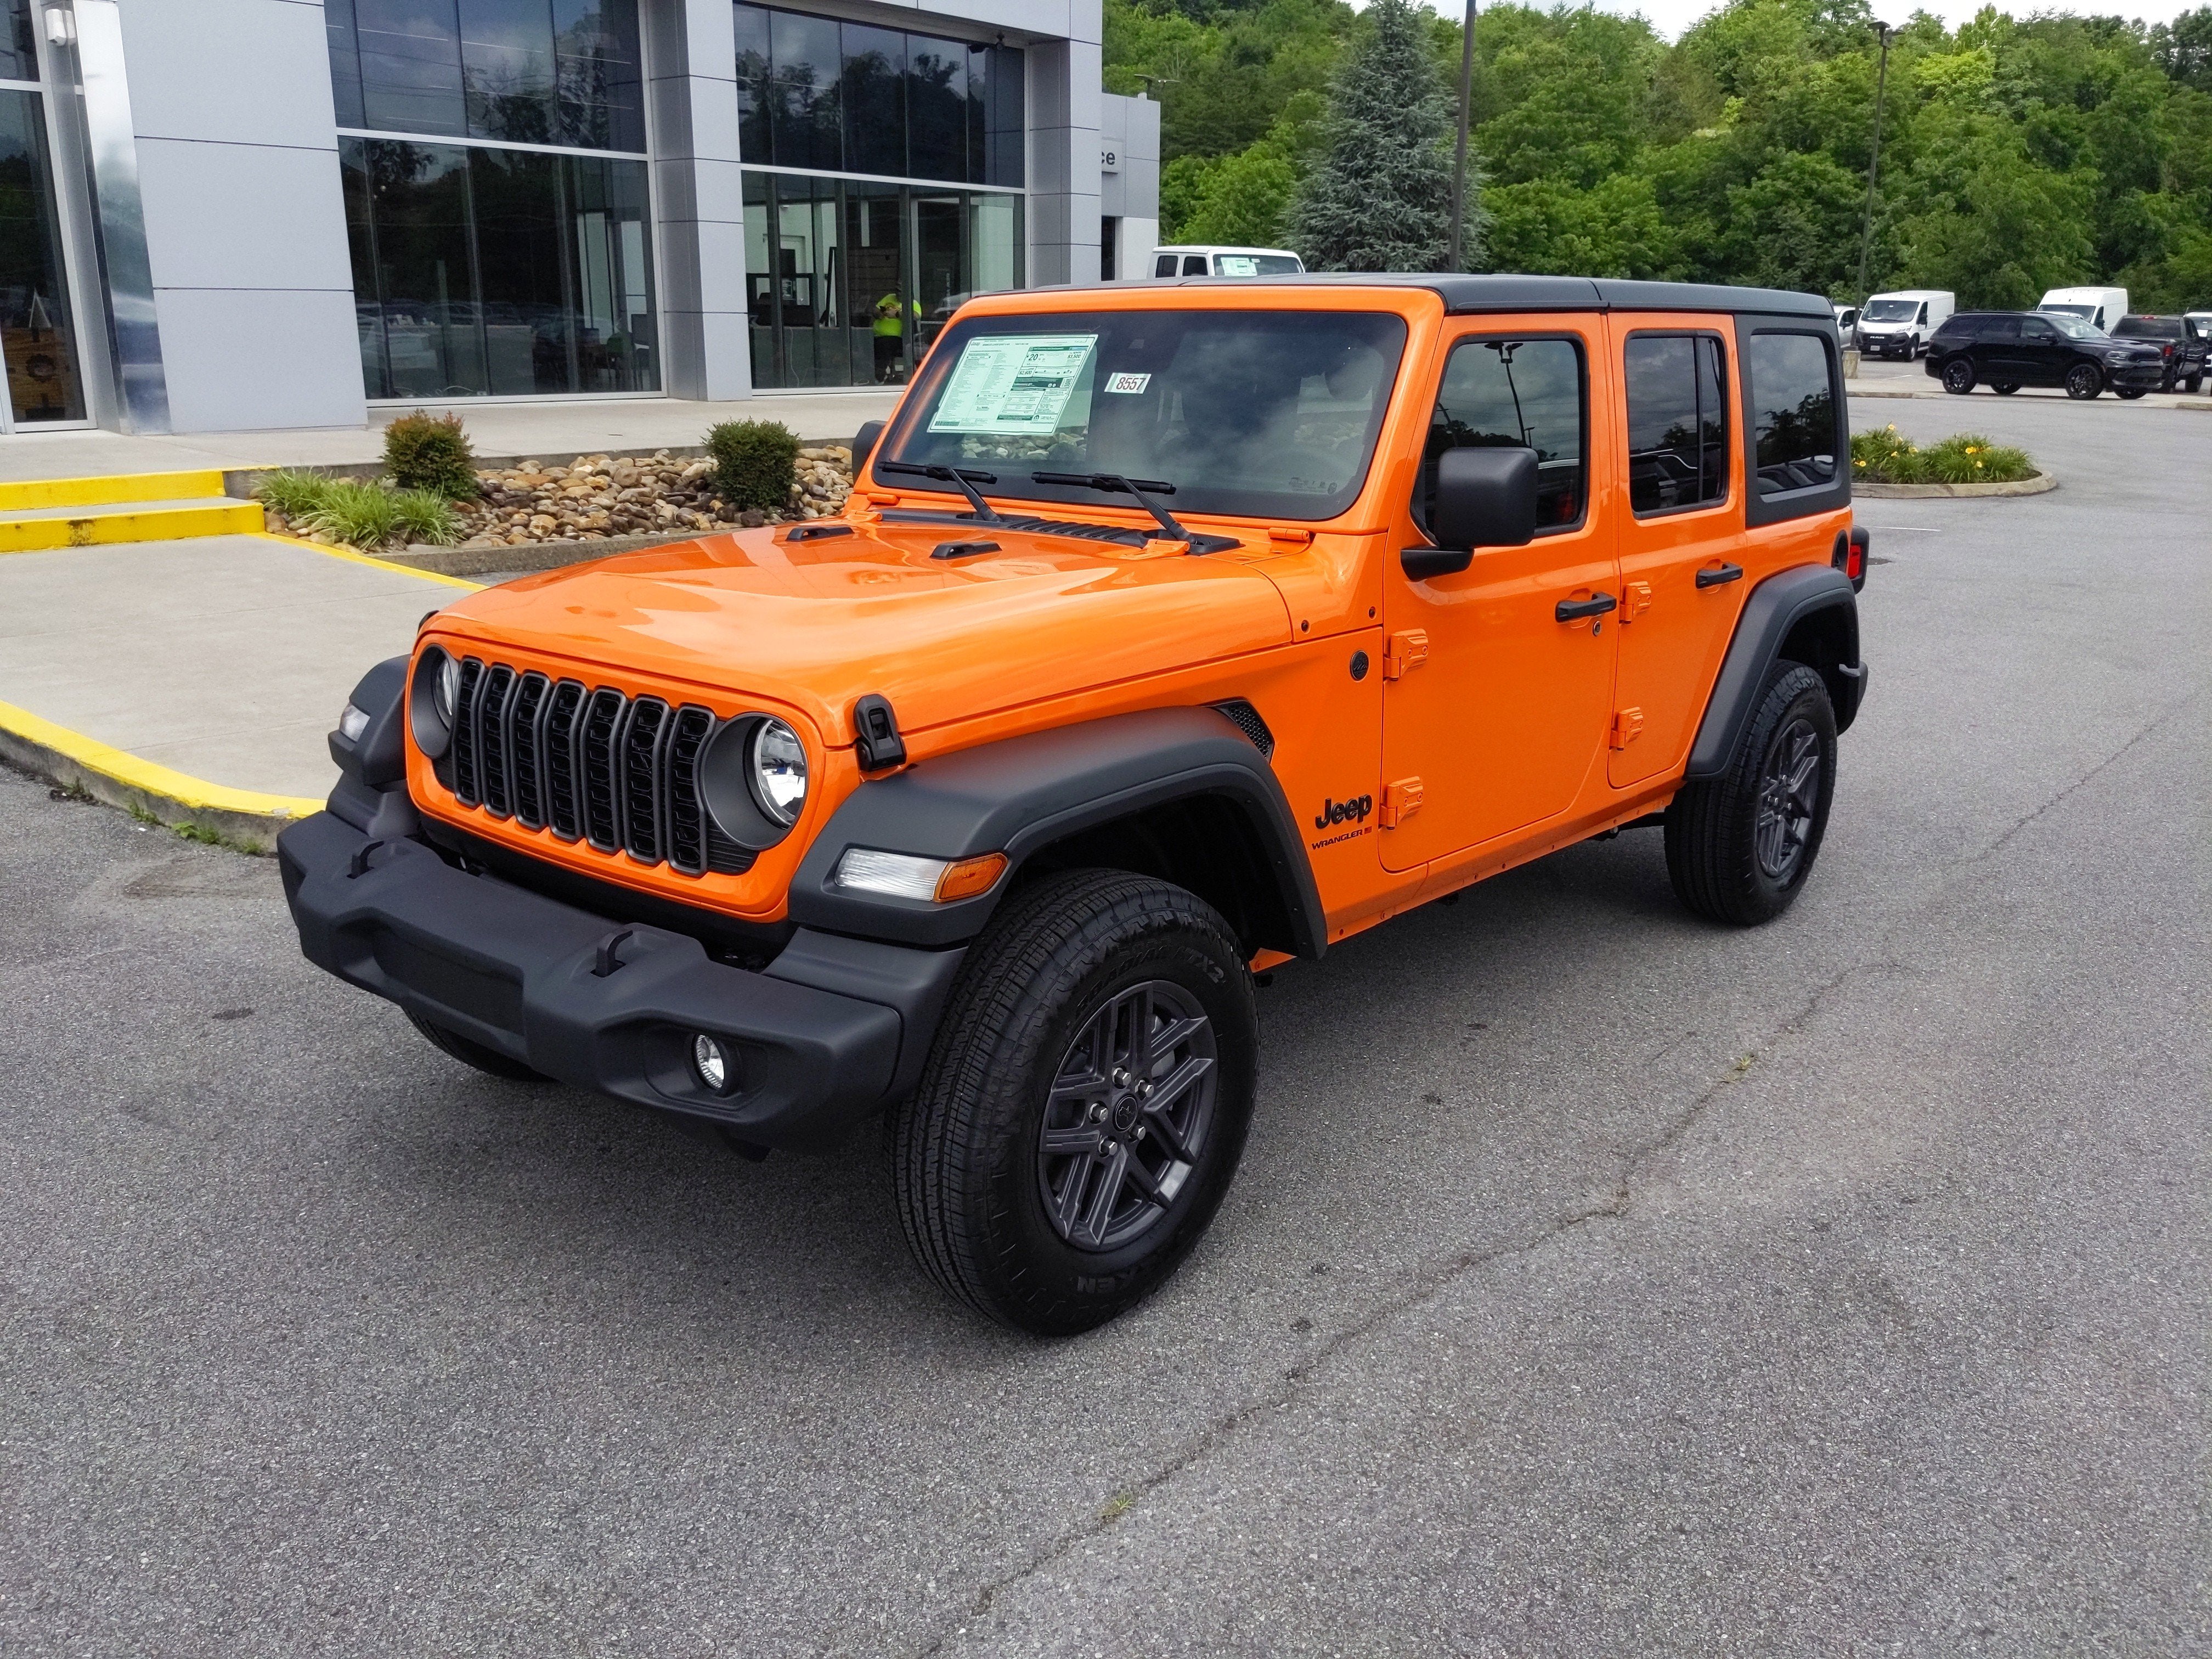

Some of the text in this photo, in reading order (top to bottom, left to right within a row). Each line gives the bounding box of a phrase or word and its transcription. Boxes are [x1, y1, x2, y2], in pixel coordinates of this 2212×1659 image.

[1116, 377, 1147, 390] 8557
[1315, 794, 1373, 829] Jeep
[1311, 829, 1363, 850] WRANGLER
